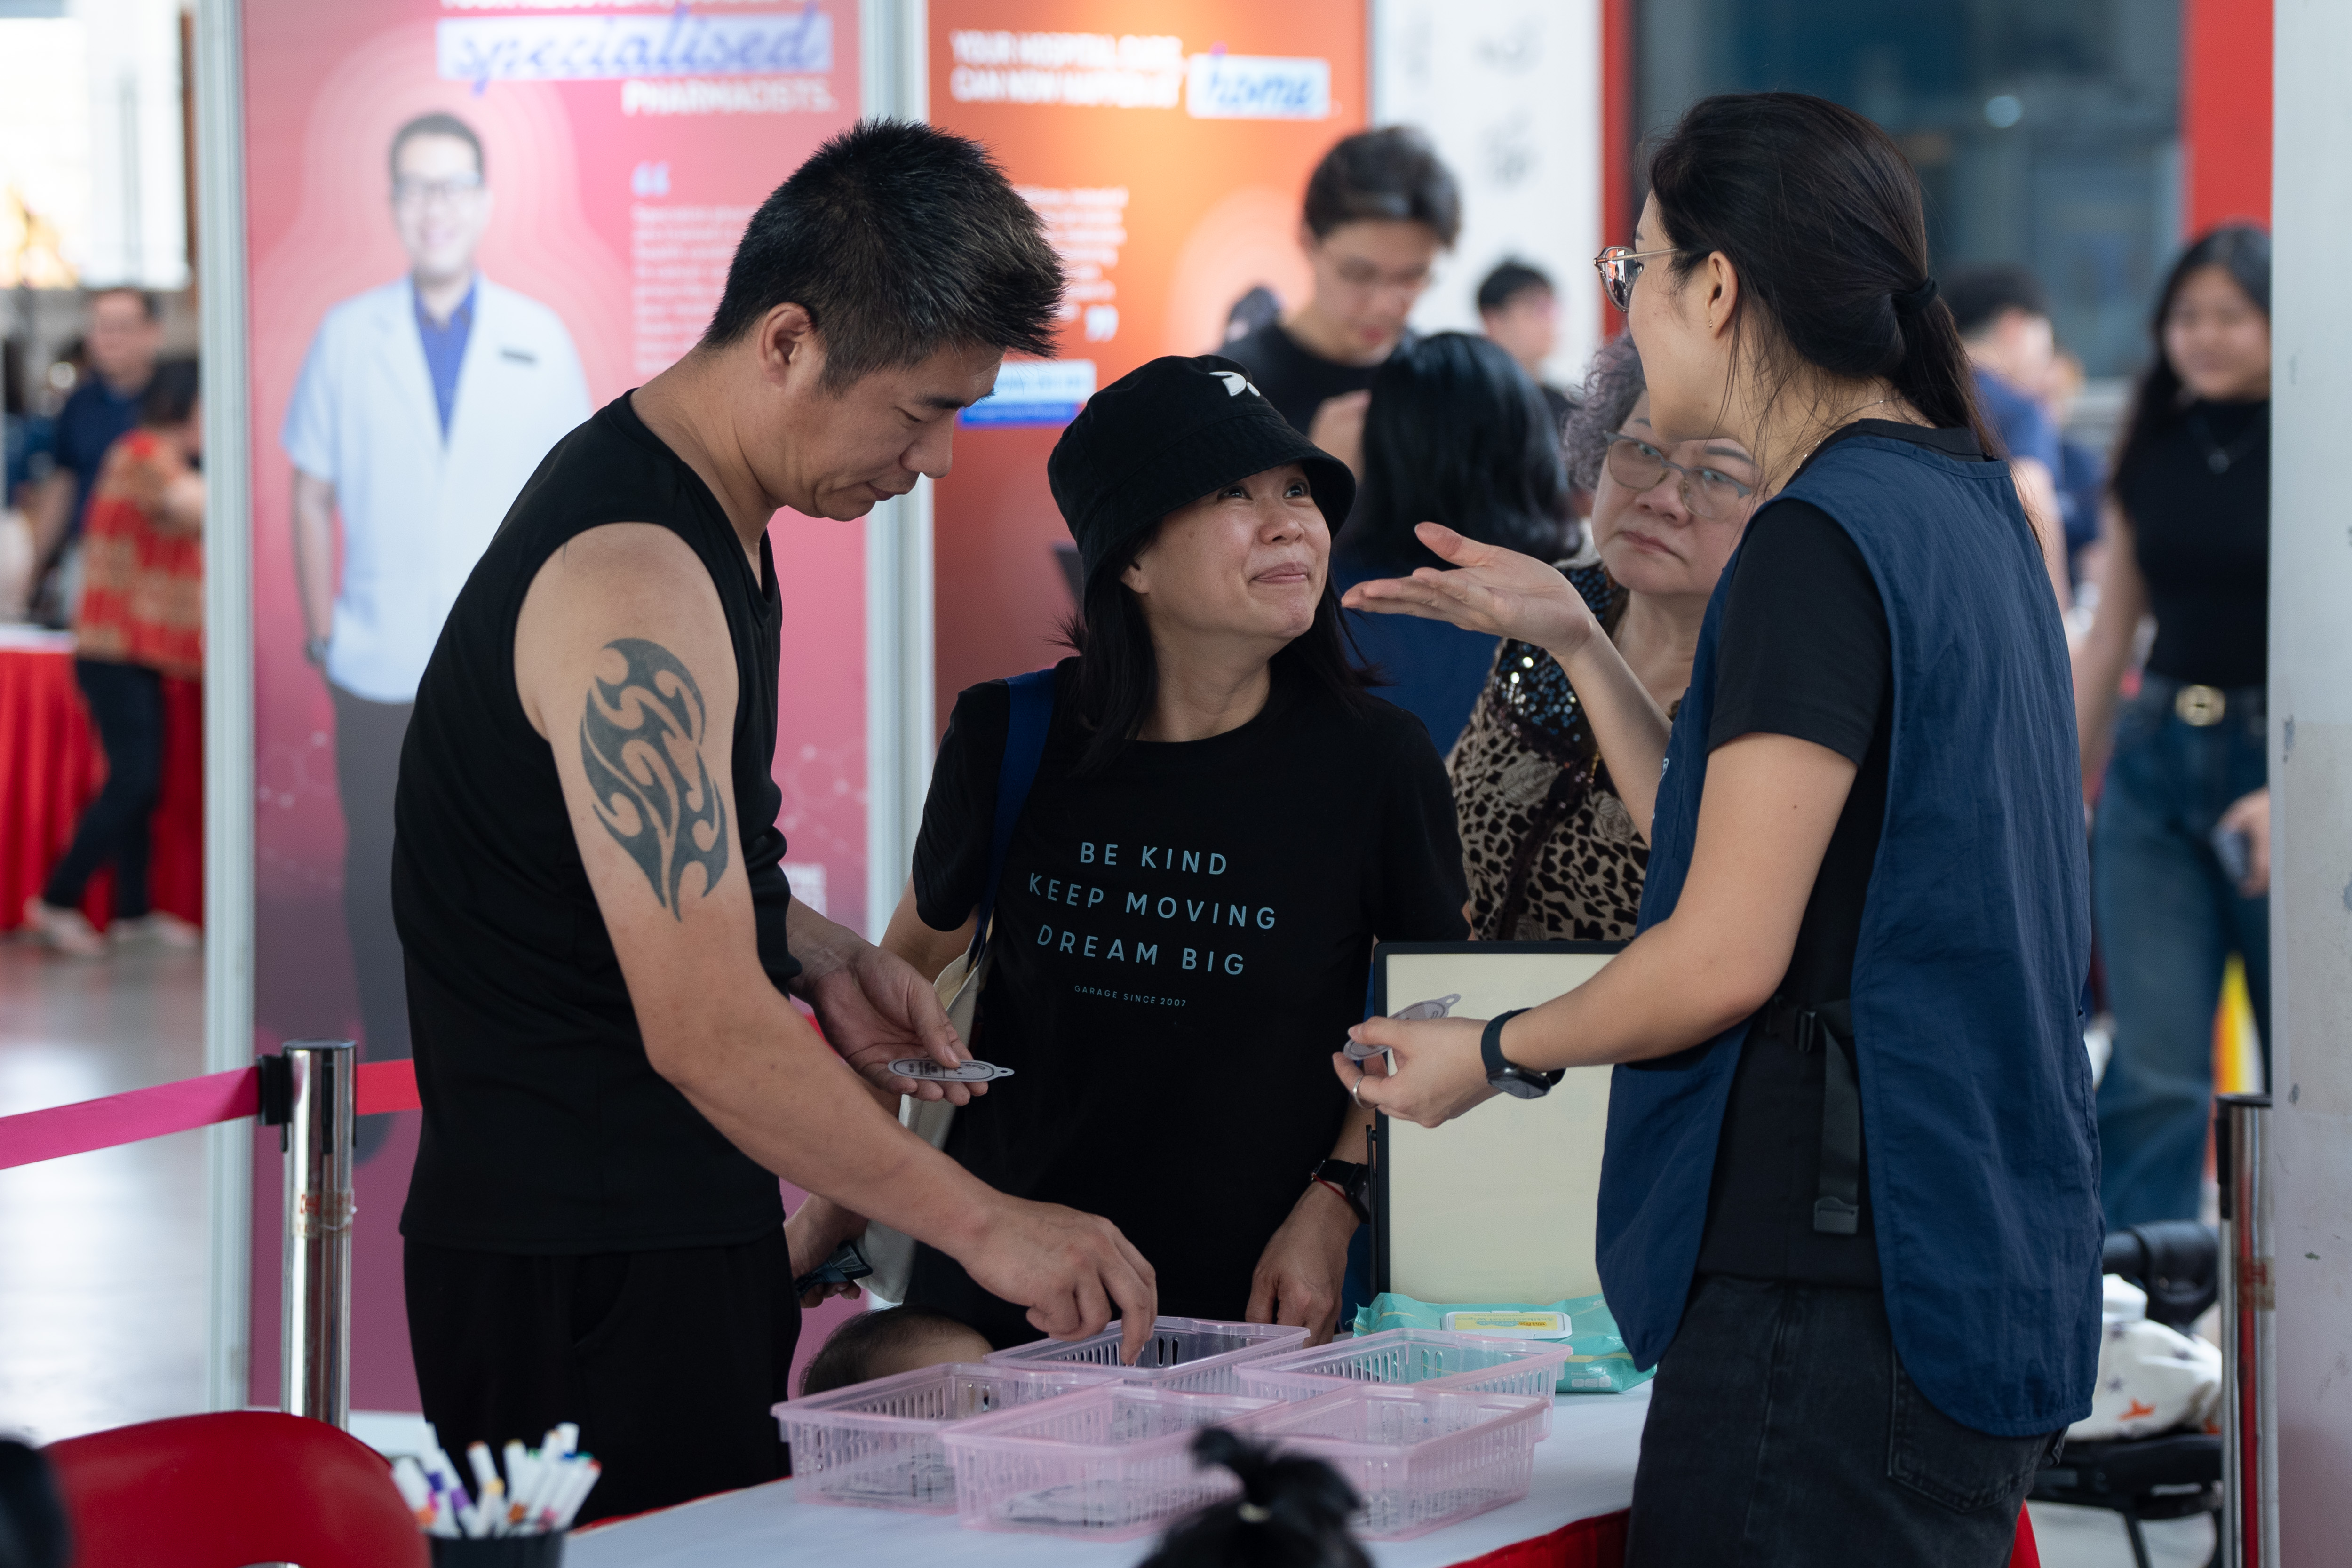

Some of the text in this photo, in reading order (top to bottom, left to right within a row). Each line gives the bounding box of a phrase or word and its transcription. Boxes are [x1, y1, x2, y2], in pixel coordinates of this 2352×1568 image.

[455, 2, 821, 96] specialised
[1080, 842, 1226, 875] BE KIND
[1030, 873, 1275, 929] KEEP MOVING
[1037, 924, 1243, 975] DREAM BIG
[1074, 985, 1186, 1006] GARAGE SINCE 2007
